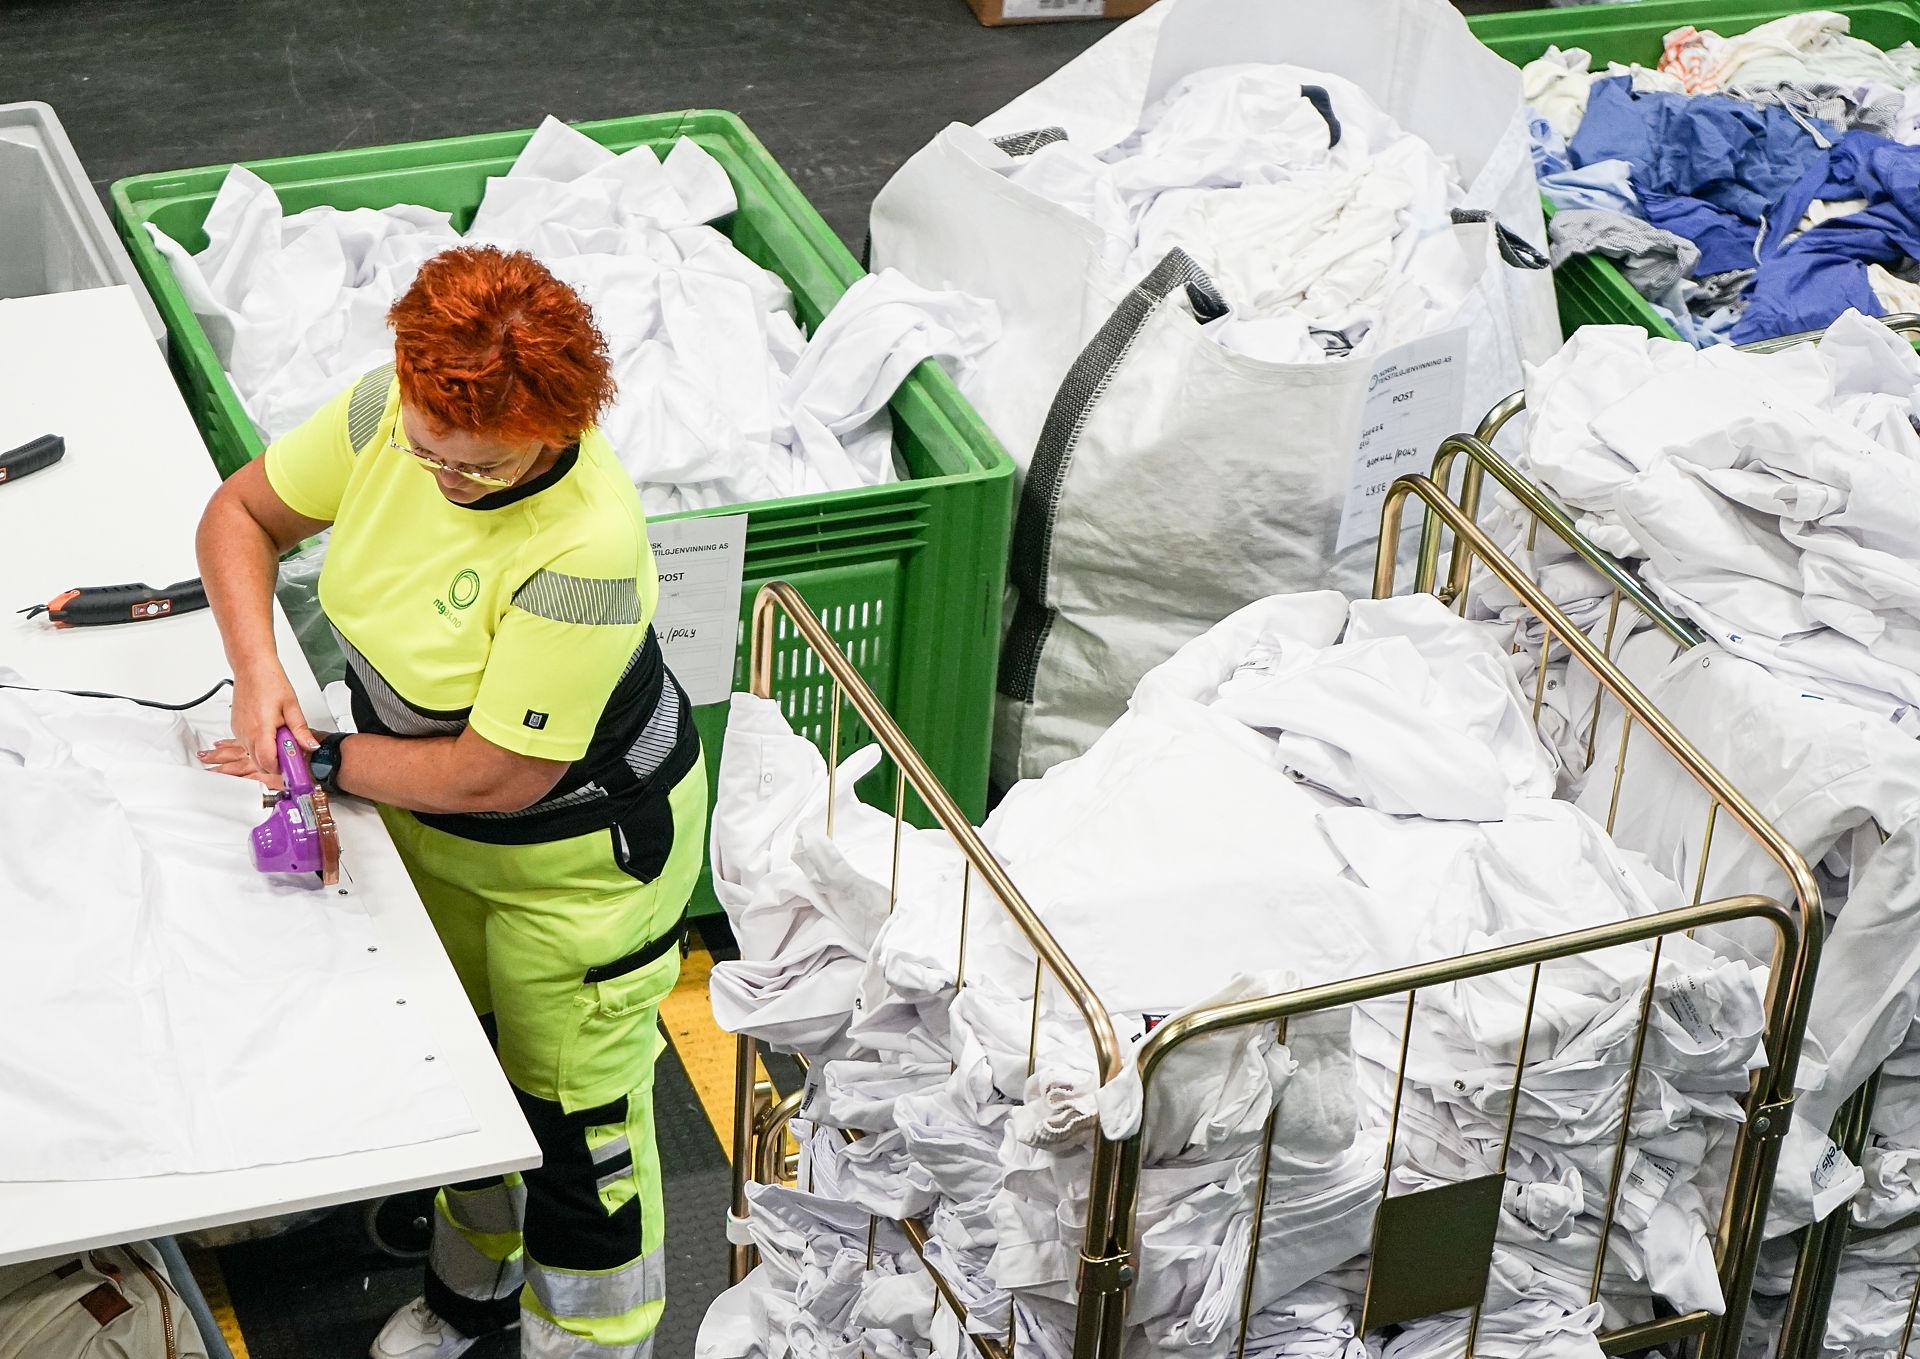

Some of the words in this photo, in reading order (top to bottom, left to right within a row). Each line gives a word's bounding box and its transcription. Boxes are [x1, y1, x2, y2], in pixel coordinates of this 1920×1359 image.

[1392, 390, 1414, 404] POST
[652, 544, 717, 557] TILGJENVINNING
[718, 542, 729, 550] AS
[658, 572, 684, 583] POST
[1822, 1145, 1836, 1171] elis
